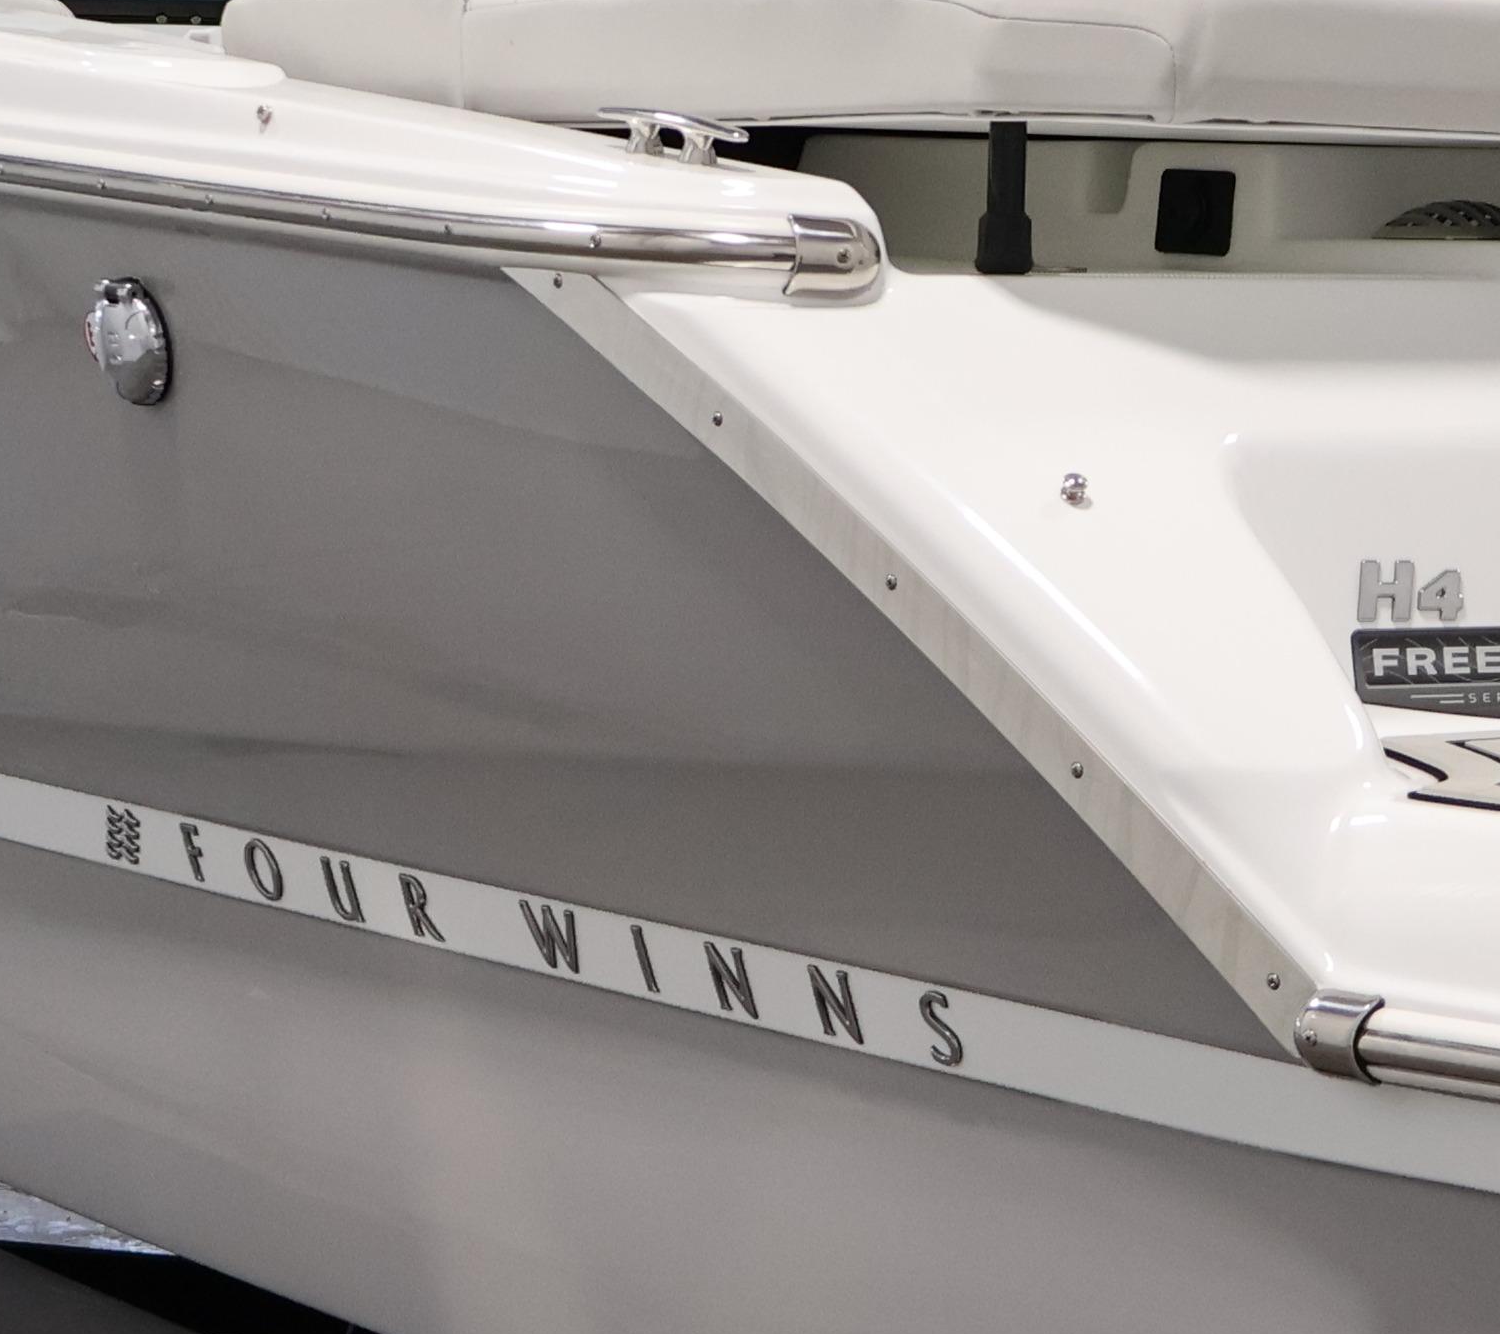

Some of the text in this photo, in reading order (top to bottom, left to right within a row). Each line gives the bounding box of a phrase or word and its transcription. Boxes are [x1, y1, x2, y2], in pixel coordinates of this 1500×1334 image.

[1357, 559, 1464, 622] H4
[179, 822, 963, 1067] FOUR WINNS
